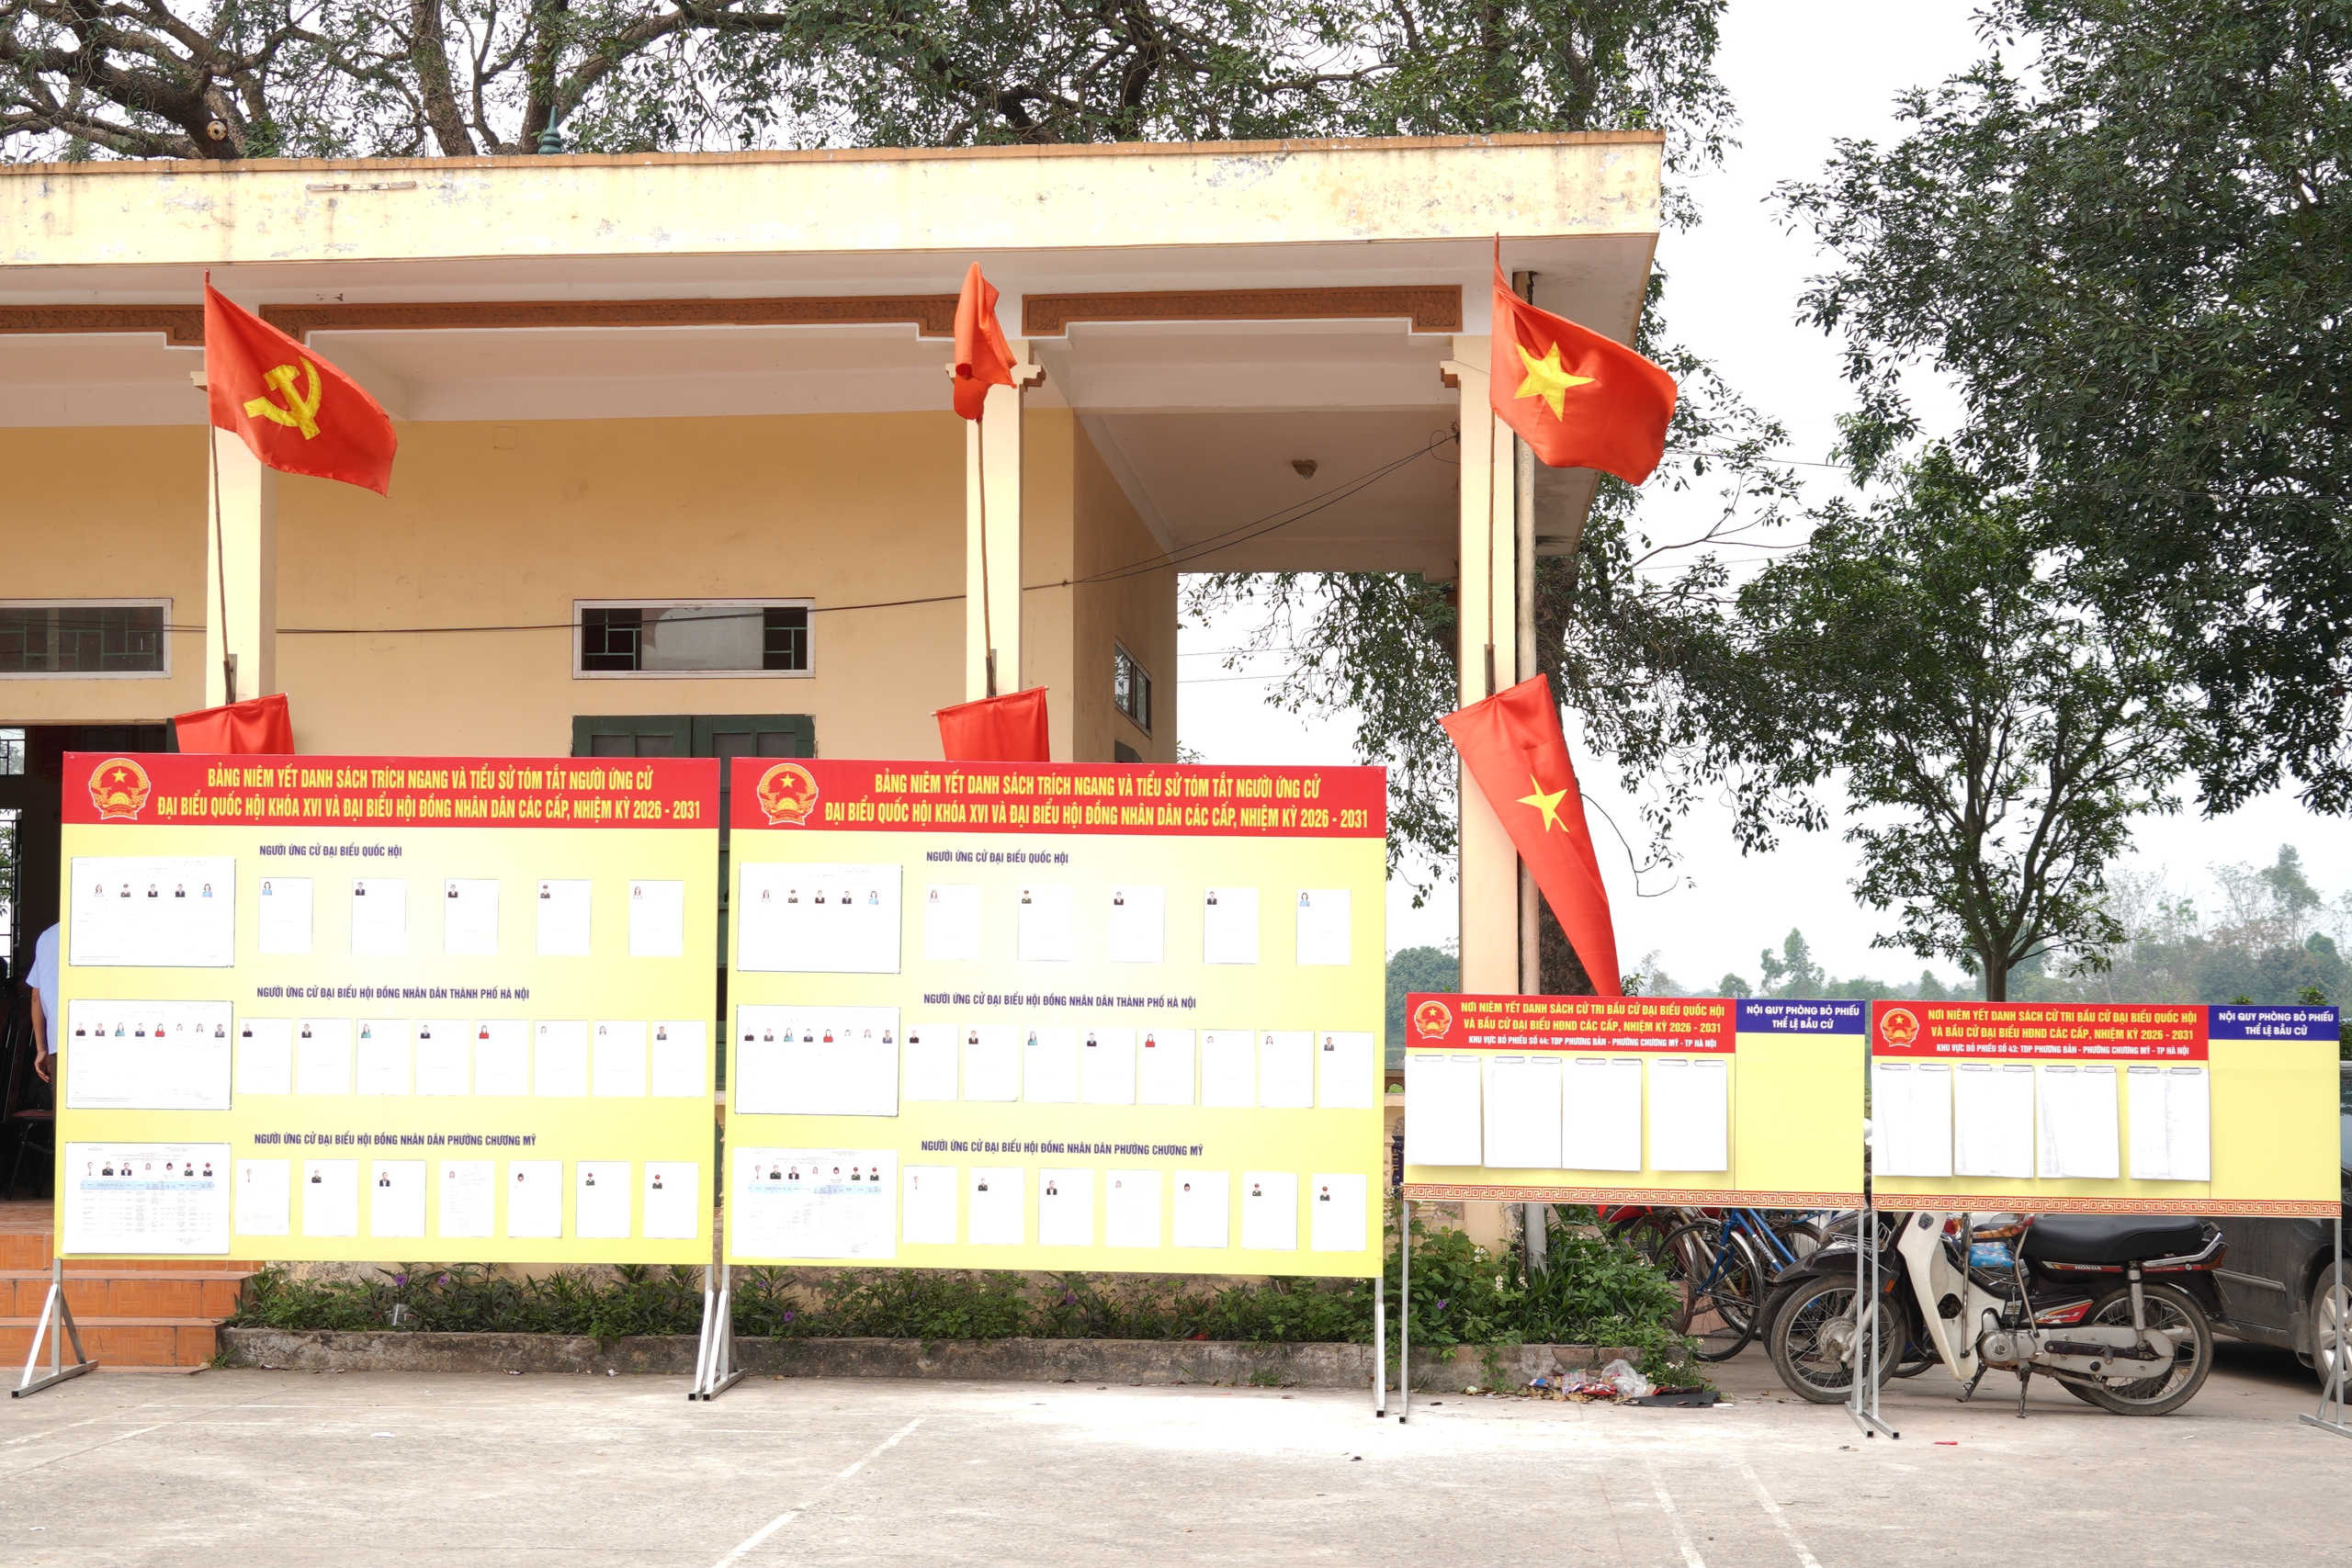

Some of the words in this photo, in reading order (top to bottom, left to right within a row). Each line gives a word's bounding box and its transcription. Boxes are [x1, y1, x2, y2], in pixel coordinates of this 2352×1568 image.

[207, 761, 241, 787] BẢNG
[243, 764, 275, 787] NIÊM
[277, 762, 299, 787] YẾT
[300, 769, 334, 787] DANH
[335, 765, 368, 788] SÁCH
[370, 765, 405, 788] TRÍCH
[407, 769, 448, 788] NGANG
[450, 765, 468, 789] VÀ
[469, 762, 495, 789] TIỂU
[497, 763, 516, 789] SỬ
[516, 766, 543, 789] TÓM
[545, 763, 567, 790] TẮT
[569, 766, 605, 790] NGƯỜI
[607, 767, 633, 790] ỨNG
[635, 764, 654, 790] CỬ
[875, 767, 908, 794] BẢNG
[910, 770, 941, 794] NIÊM
[944, 768, 966, 794] YẾT
[967, 774, 1000, 794] DANH
[1002, 771, 1035, 795] SÁCH
[1036, 772, 1071, 795] TRÍCH
[1073, 776, 1115, 796] NGANG
[1117, 773, 1134, 795] VÀ
[1136, 770, 1162, 796] TIỂU
[1164, 771, 1182, 796] SỬ
[1183, 773, 1209, 797] TÓM
[1212, 771, 1234, 797] TẮT
[1236, 773, 1272, 798] NGƯỜI
[1275, 774, 1301, 798] ỨNG
[1303, 773, 1321, 798] CỬ
[156, 796, 177, 819] ĐẠI
[180, 789, 208, 816] BIỂU
[209, 790, 243, 818] QUỐC
[244, 793, 266, 820] HỘI
[267, 793, 300, 817] KHÓA
[301, 797, 322, 817] XVI
[324, 794, 341, 817] VÀ
[342, 797, 364, 821] ĐẠI
[366, 790, 393, 818] BIỂU
[395, 794, 416, 821] HỘI
[418, 792, 452, 818] ĐỒNG
[454, 795, 488, 818] NHÂN
[490, 795, 515, 818] DÂN
[517, 795, 542, 818] CÁC
[545, 793, 571, 820] CẤP,
[572, 795, 612, 823] NHIỆM
[614, 795, 631, 818] KỲ
[632, 799, 662, 818] 2026
[672, 800, 700, 819] 2031
[259, 842, 287, 856] NGƯỜI
[288, 843, 307, 856] ỨNG
[308, 842, 322, 857] CỬ
[322, 845, 337, 859] ĐẠI
[339, 841, 360, 857] BIỂU
[361, 842, 385, 858] QUỐC
[387, 844, 402, 859] HỘI
[923, 991, 950, 1005] NGƯỜI
[952, 992, 971, 1005] ỨNG
[972, 991, 986, 1005] CỬ
[986, 994, 1001, 1008] ĐẠI
[1003, 990, 1023, 1006] BIỂU
[1025, 993, 1041, 1009] HỘI
[1042, 992, 1067, 1007] ĐỒNG
[1069, 994, 1093, 1007] NHÂN
[1095, 994, 1114, 1008] DÂN
[1115, 995, 1145, 1008] THÀNH
[1147, 994, 1165, 1009] PHỐ
[1166, 995, 1179, 1009] HÀ
[1181, 996, 1196, 1010] NỘI
[1460, 1000, 1477, 1012] NƠI
[1478, 1000, 1503, 1012] NIÊM
[1504, 999, 1521, 1013] YẾT
[1521, 1003, 1547, 1013] DANH
[1549, 1001, 1574, 1014] SÁCH
[1576, 1000, 1589, 1014] CỬ
[1589, 1004, 1605, 1014] TRI
[1606, 1000, 1625, 1014] BẦU
[1627, 1001, 1641, 1015] CỬ
[1641, 1004, 1657, 1017] ĐẠI
[1659, 1001, 1680, 1015] BIỂU
[1682, 1002, 1707, 1017] QUỐC
[1709, 1004, 1724, 1018] HỘI
[1463, 1016, 1476, 1029] VÀ
[1476, 1015, 1496, 1029] BẦU
[1497, 1016, 1511, 1030] CỬ
[1511, 1019, 1528, 1032] ĐẠI
[1529, 1016, 1551, 1030] BIỂU
[1552, 1020, 1577, 1031] HĐND
[1579, 1018, 1599, 1031] CÁC
[1600, 1017, 1622, 1032] CẤP,
[1623, 1019, 1654, 1033] NHIỆM
[1655, 1020, 1668, 1032] KỲ
[1668, 1021, 1691, 1032] 2026
[1699, 1022, 1721, 1032] 2031
[1927, 1009, 1945, 1020] NƠI
[1946, 1008, 1971, 1021] NIÊM
[1972, 1007, 1989, 1021] YẾT
[1990, 1010, 2017, 1021] DANH
[2018, 1009, 2043, 1021] SÁCH
[2044, 1008, 2060, 1021] CỬ
[2059, 1011, 2075, 1021] TRI
[2076, 1008, 2096, 1022] BẦU
[2097, 1009, 2112, 1022] CỬ
[2111, 1011, 2129, 1024] ĐẠI
[2130, 1009, 2153, 1022] BIỂU
[2154, 1009, 2179, 1023] QUỐC
[2180, 1010, 2198, 1025] HỘI
[2218, 1010, 2236, 1022] NỘI
[2236, 1012, 2257, 1021] QUY
[2257, 1010, 2292, 1021] PHÒNG
[2292, 1010, 2307, 1021] BỎ
[2308, 1010, 2334, 1021] PHIẾU
[2244, 1023, 2262, 1034] THỂ
[2262, 1024, 2272, 1037] LỆ
[2273, 1023, 2292, 1035] BẦU
[2292, 1024, 2308, 1035] CỬ
[254, 1131, 281, 1145] NGƯỜI
[283, 1132, 301, 1145] ỨNG
[303, 1131, 317, 1145] CỬ
[317, 1134, 333, 1147] ĐẠI
[334, 1130, 355, 1145] BIỂU
[356, 1132, 372, 1147] HỘI
[373, 1131, 398, 1145] ĐỒNG
[400, 1133, 424, 1145] NHÂN
[426, 1133, 446, 1145] DÂN
[447, 1133, 483, 1146] PHƯỜNG
[484, 1134, 521, 1146] CHƯƠNG
[522, 1134, 537, 1146] MỸ
